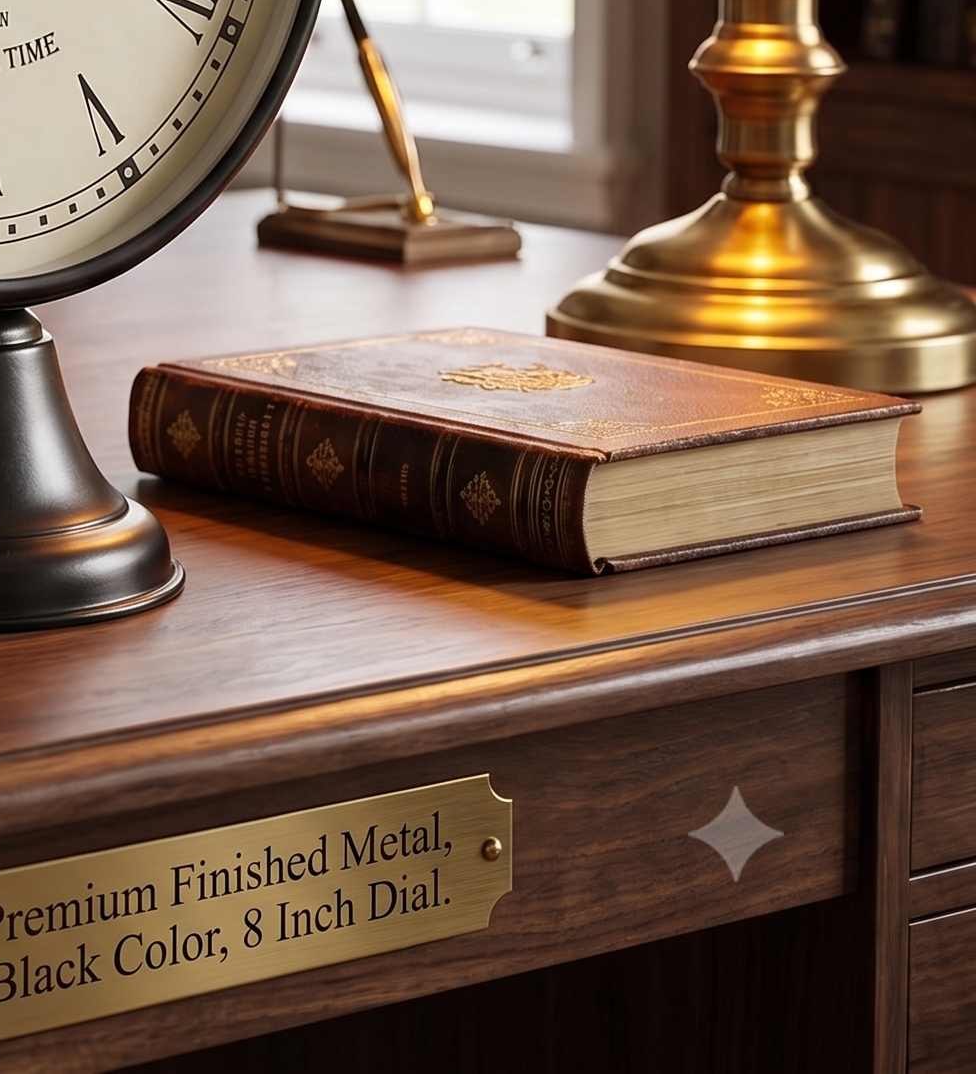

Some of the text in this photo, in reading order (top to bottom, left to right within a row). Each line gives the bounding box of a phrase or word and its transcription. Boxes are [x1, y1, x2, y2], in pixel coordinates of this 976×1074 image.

[2, 31, 61, 70] TIME
[77, 72, 126, 157] V
[169, 835, 330, 908] Finished
[339, 811, 454, 871] Metal,
[112, 924, 230, 977] Color,
[242, 907, 264, 949] 8
[275, 887, 356, 944] Inch
[367, 868, 452, 922] Dial.
